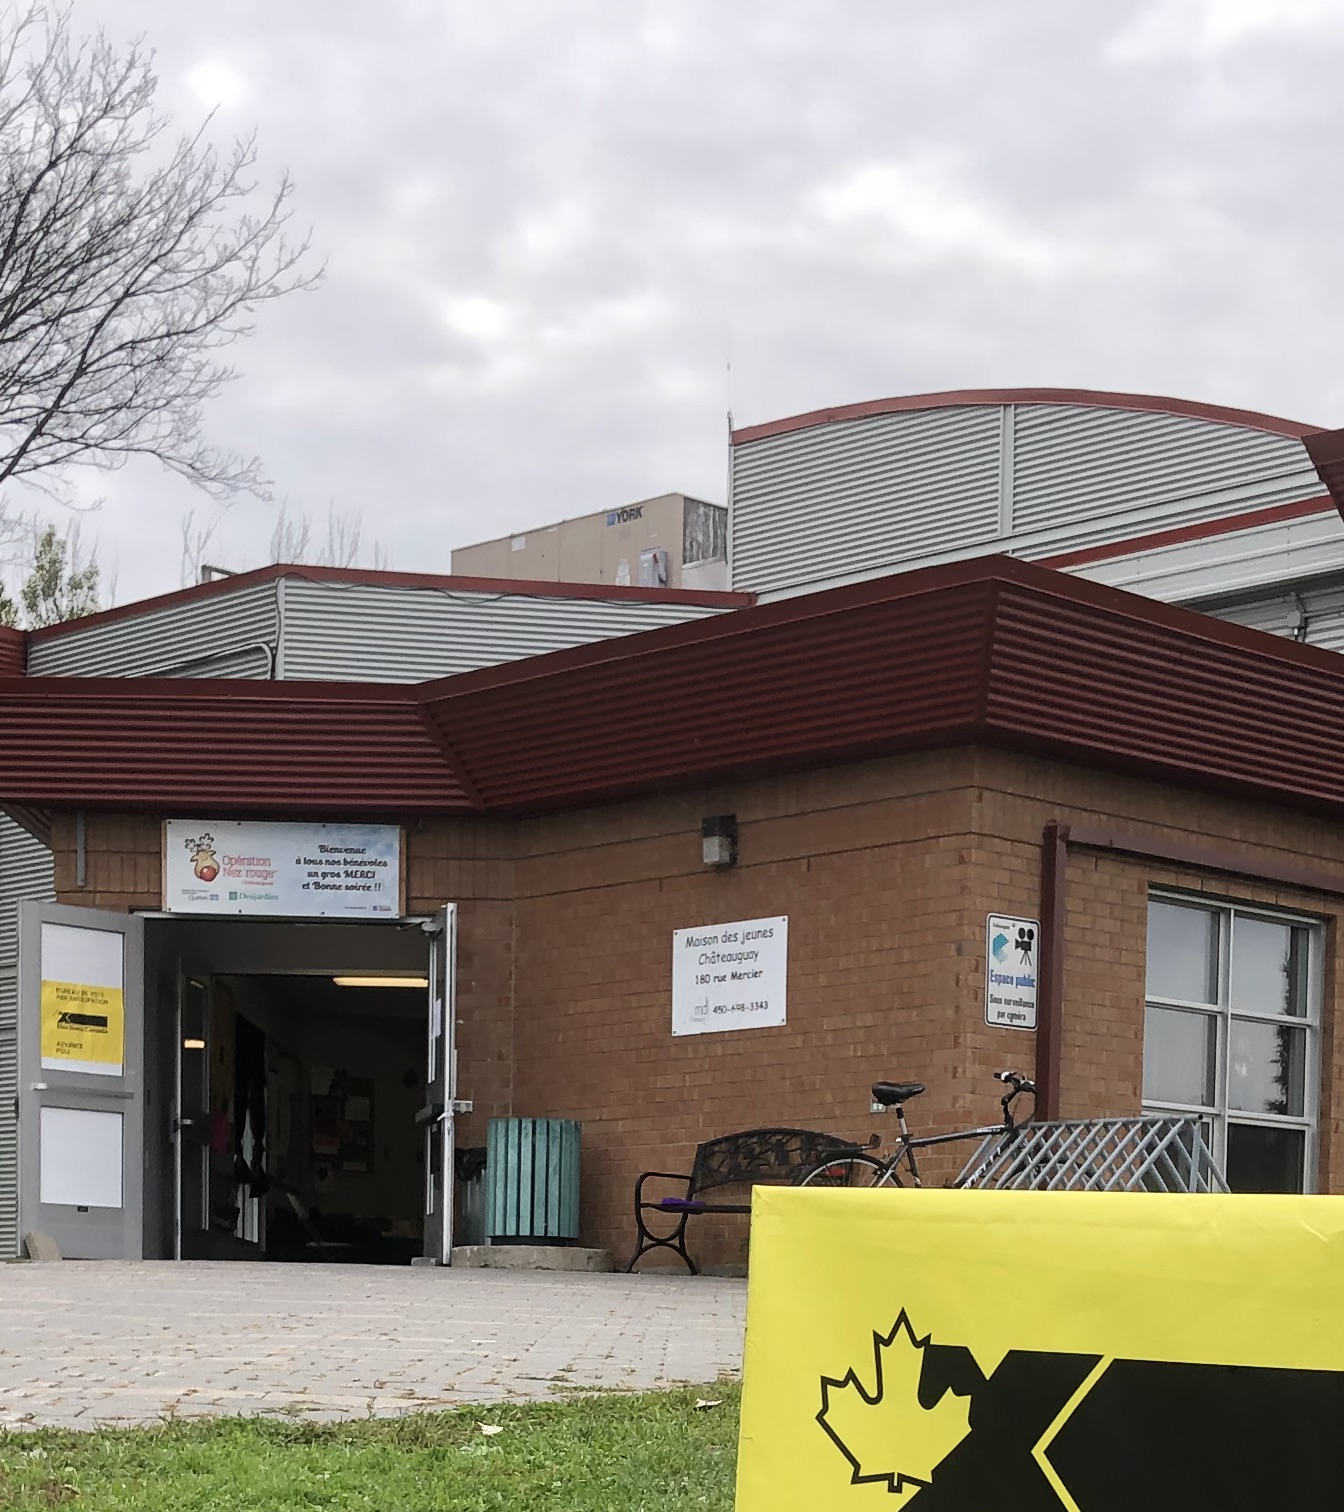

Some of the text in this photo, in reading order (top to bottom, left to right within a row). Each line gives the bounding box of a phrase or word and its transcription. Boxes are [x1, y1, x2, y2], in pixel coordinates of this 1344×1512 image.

[617, 506, 644, 523] YORK
[319, 845, 366, 854] Bienvenue
[222, 855, 271, 867] Opération
[222, 867, 242, 877] Nez
[321, 871, 341, 880] gros
[343, 870, 375, 879] MERCI
[312, 881, 343, 890] Bonne
[686, 928, 774, 948] Maison des jeunes
[698, 951, 759, 965] Châteauguay
[695, 969, 763, 985] 180 rue Mercier
[990, 969, 1014, 987] Espace
